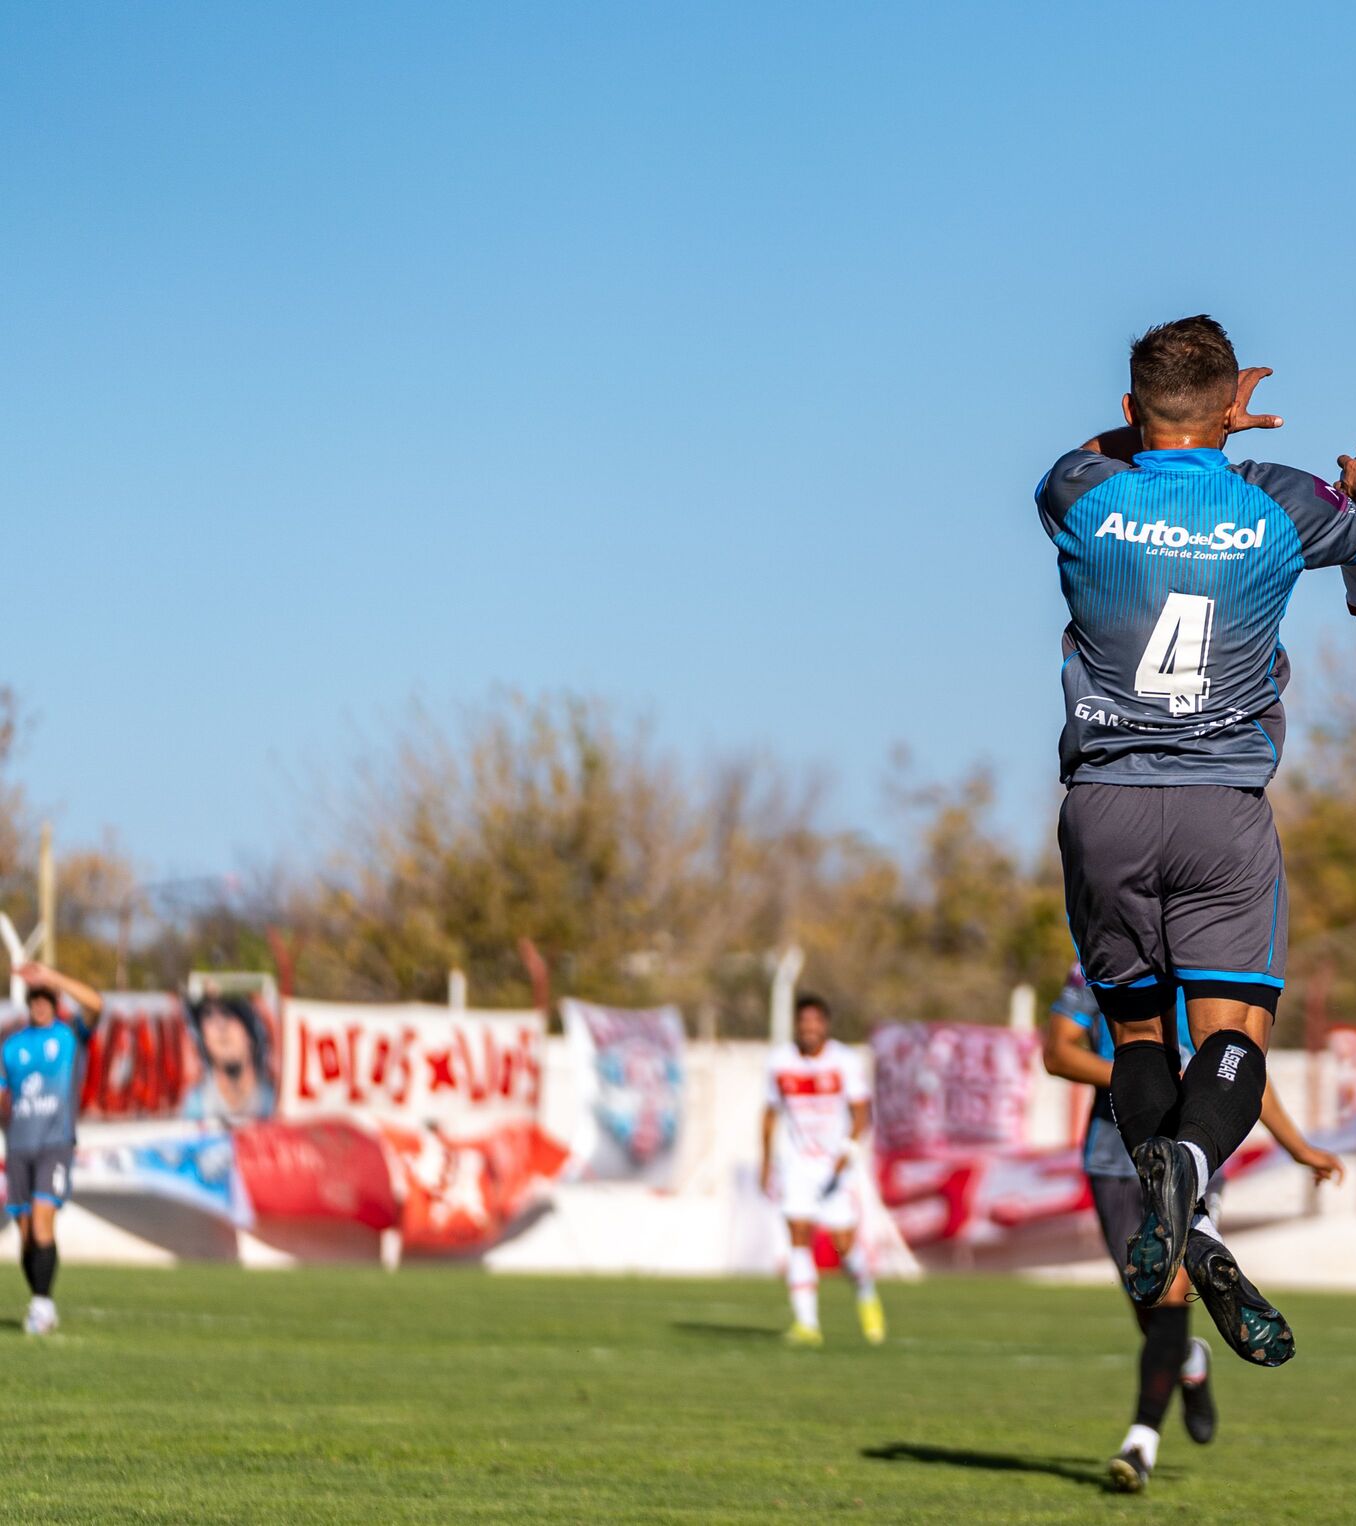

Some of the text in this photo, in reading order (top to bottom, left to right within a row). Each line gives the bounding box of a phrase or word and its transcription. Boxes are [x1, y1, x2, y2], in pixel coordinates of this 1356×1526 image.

[1146, 546, 1245, 561] La Fiat de Zona Norte
[1134, 592, 1214, 717] 4
